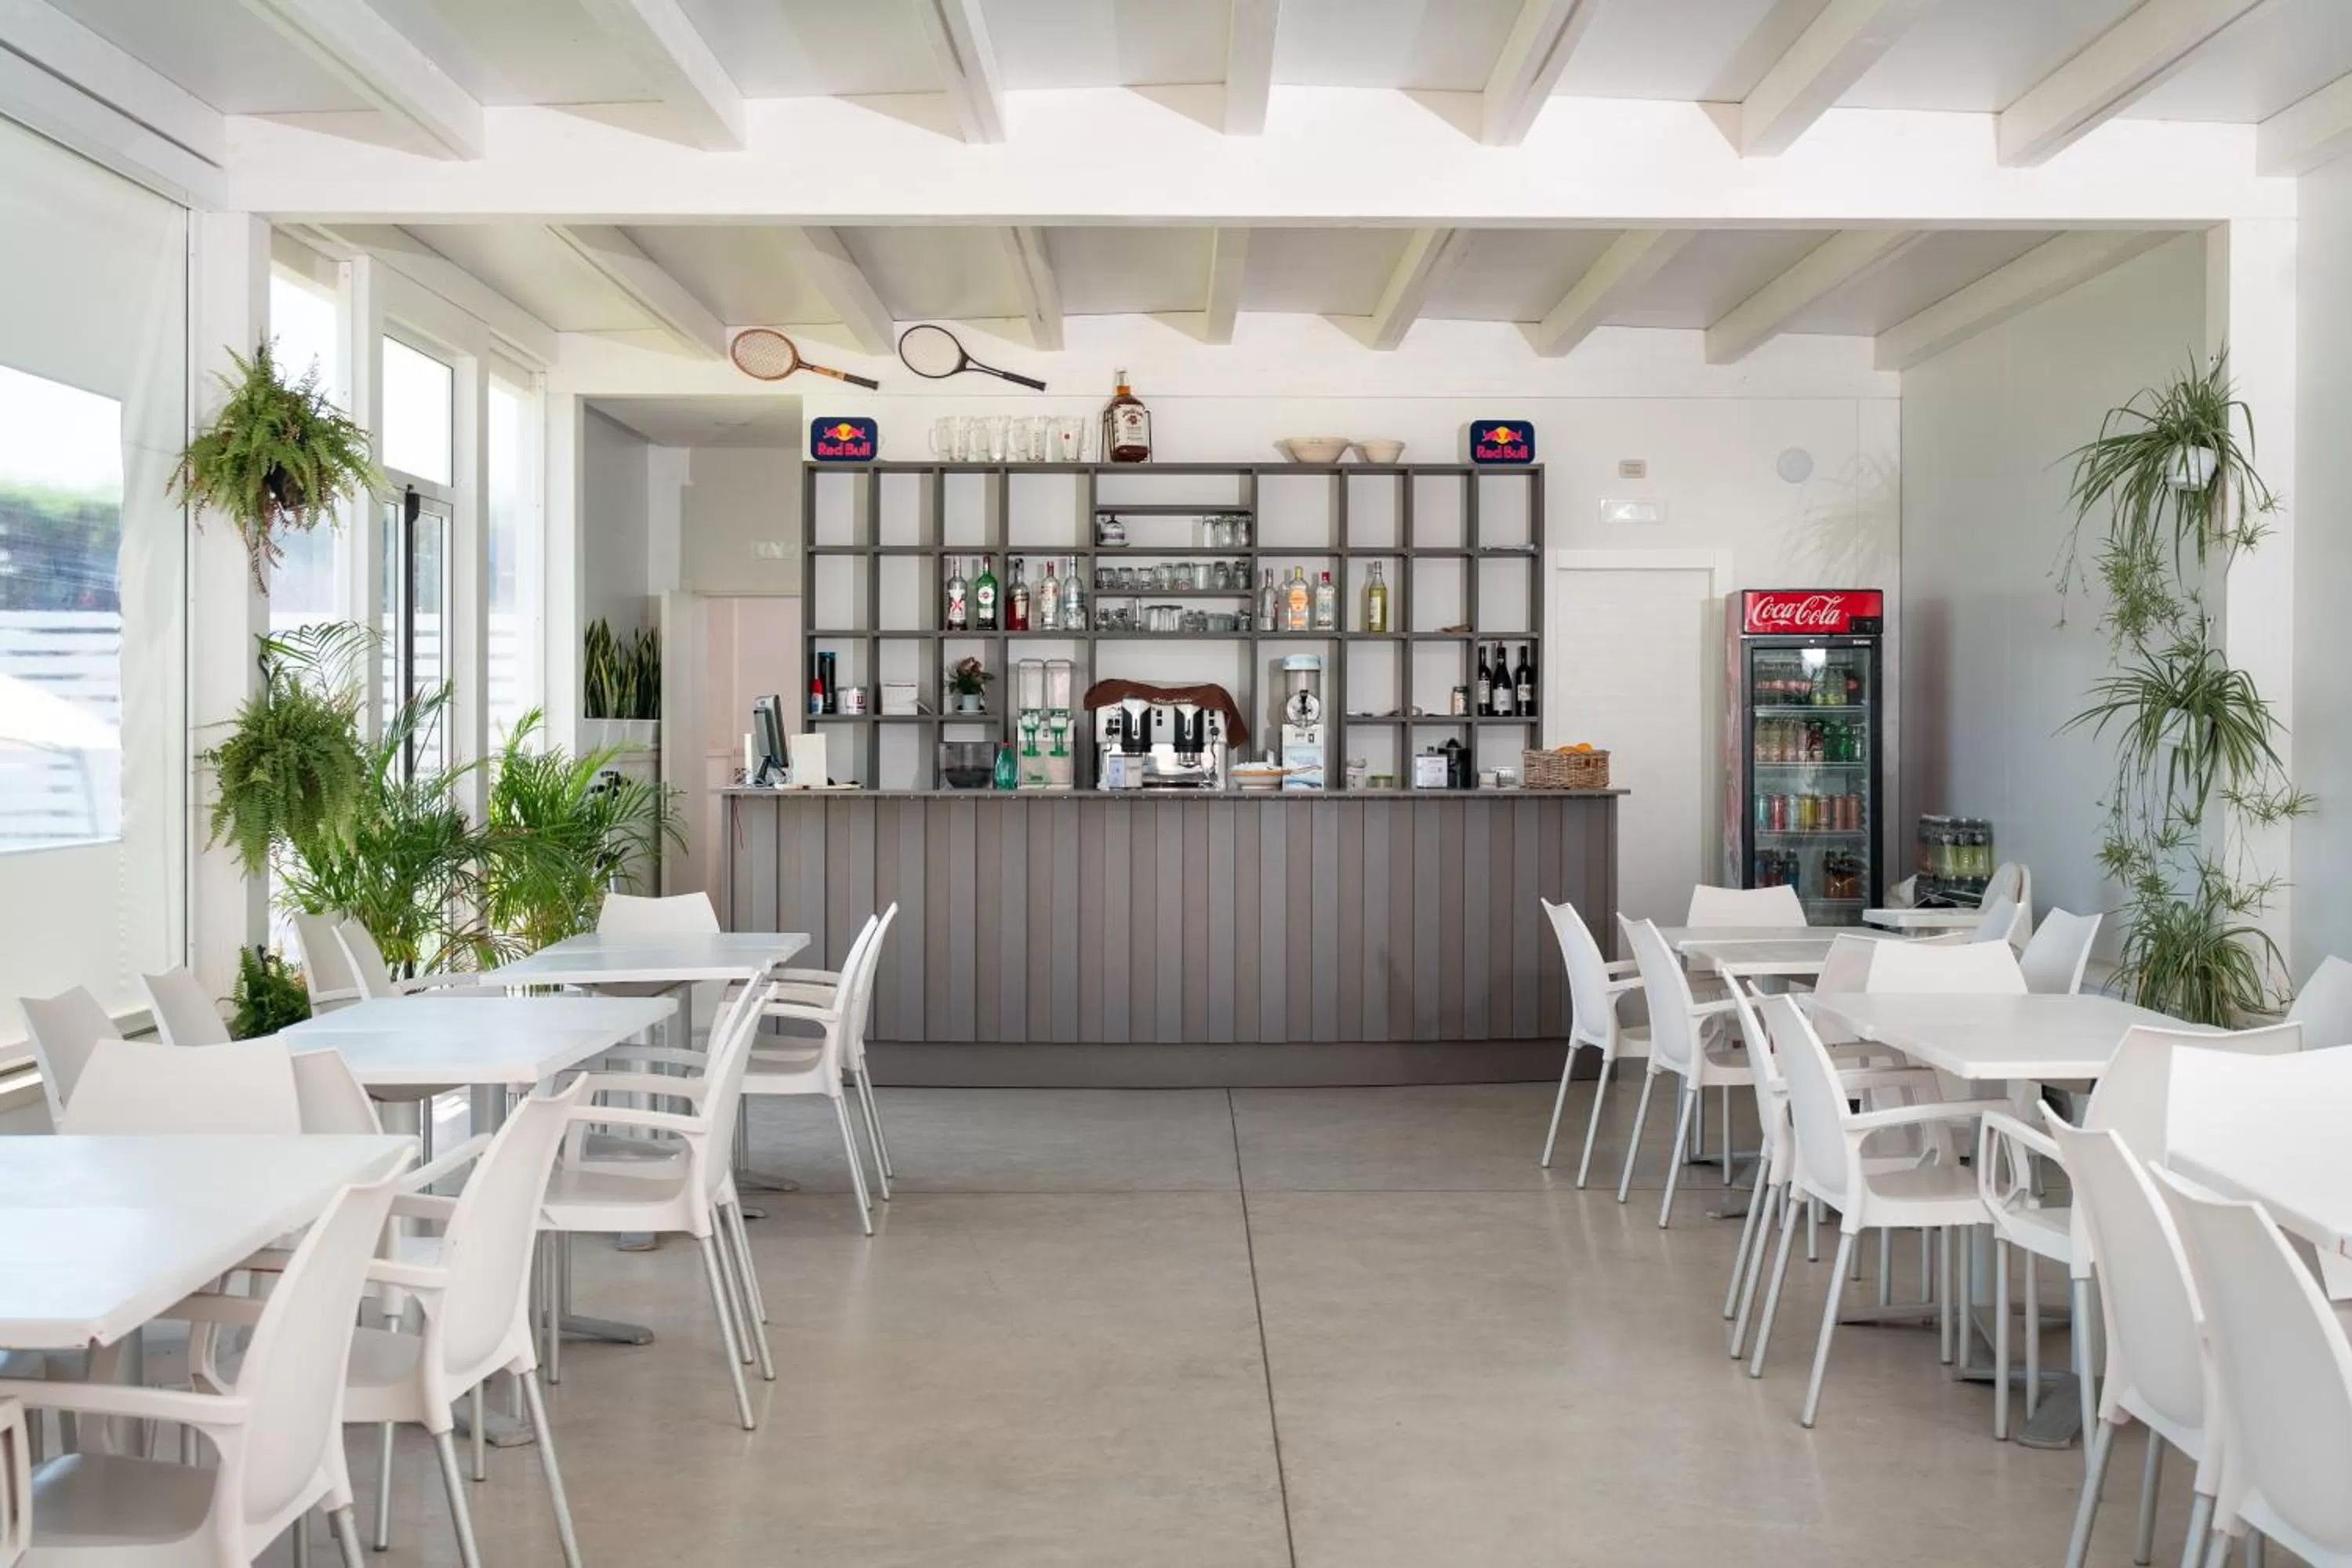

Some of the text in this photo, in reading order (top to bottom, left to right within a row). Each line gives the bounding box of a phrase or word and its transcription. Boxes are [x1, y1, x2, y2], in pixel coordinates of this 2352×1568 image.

[818, 441, 870, 456] Red Bull
[1476, 445, 1528, 459] Red Bull
[1752, 595, 1845, 626] Coca-Cola
